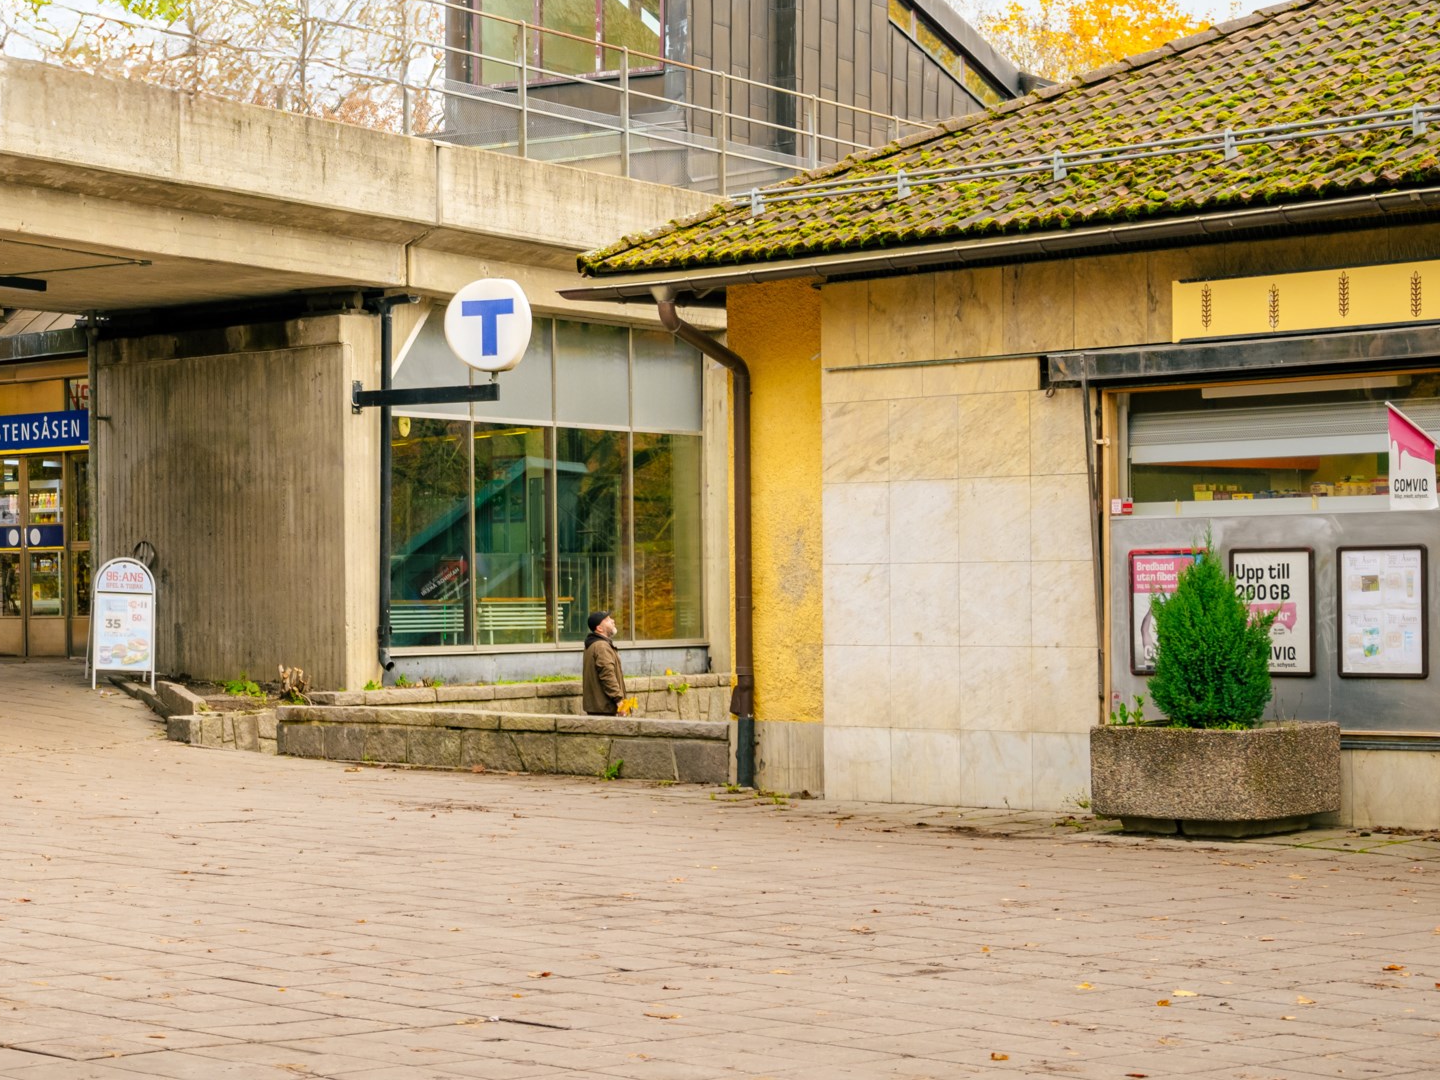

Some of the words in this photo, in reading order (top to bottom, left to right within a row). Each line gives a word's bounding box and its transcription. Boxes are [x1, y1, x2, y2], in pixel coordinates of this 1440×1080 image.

[462, 298, 513, 356] T
[1394, 478, 1429, 492] COMVIQ
[1136, 561, 1174, 571] Bredband
[1235, 563, 1264, 583] Upp
[1268, 563, 1290, 579] till
[1136, 573, 1155, 581] utan
[1235, 584, 1266, 601] 200
[1270, 584, 1290, 601] GB
[1278, 611, 1291, 621] kr
[105, 619, 121, 629] 35
[1270, 646, 1296, 661] VIQ
